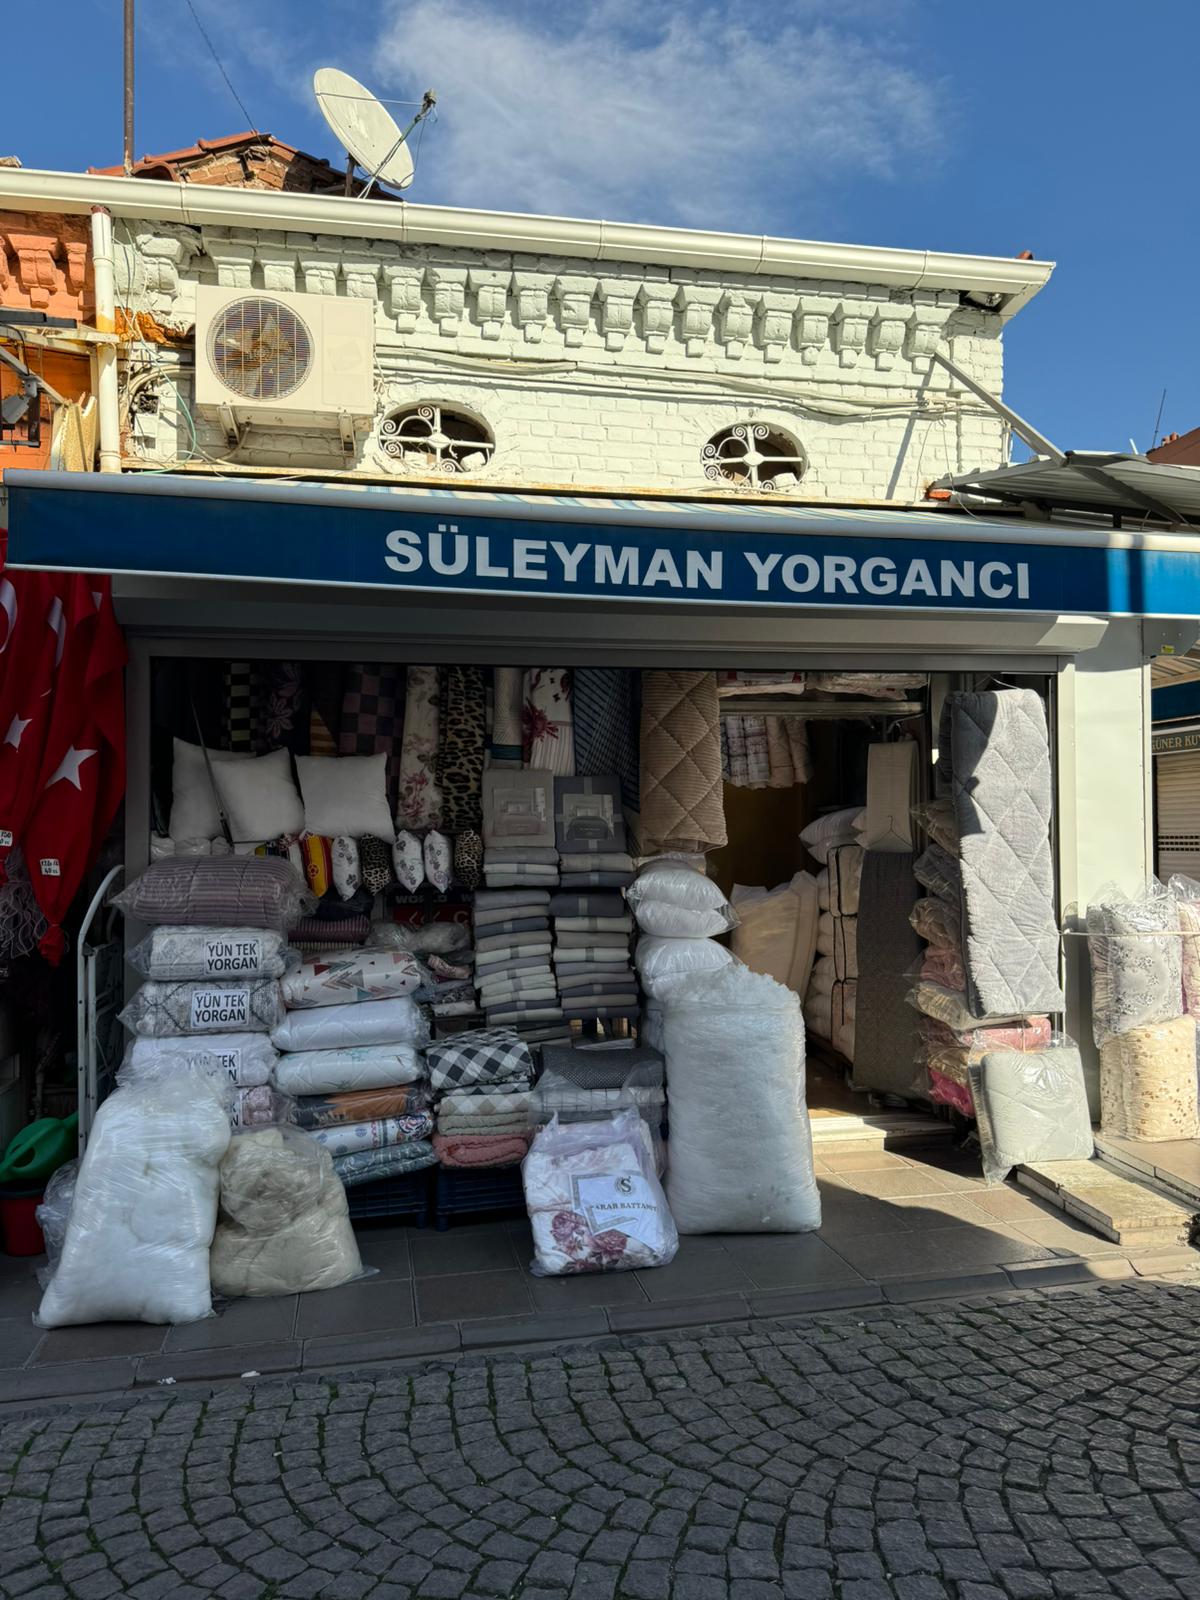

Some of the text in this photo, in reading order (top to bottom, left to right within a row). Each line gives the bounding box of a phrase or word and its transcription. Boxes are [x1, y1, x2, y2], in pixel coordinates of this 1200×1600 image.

[384, 523, 1030, 600] SÜLEYMAN YORGANCI
[208, 941, 257, 958] YÜN TEK
[207, 957, 258, 971] YORGAN
[196, 992, 245, 1009] YÜN TEK
[195, 1008, 246, 1023] YORGAN
